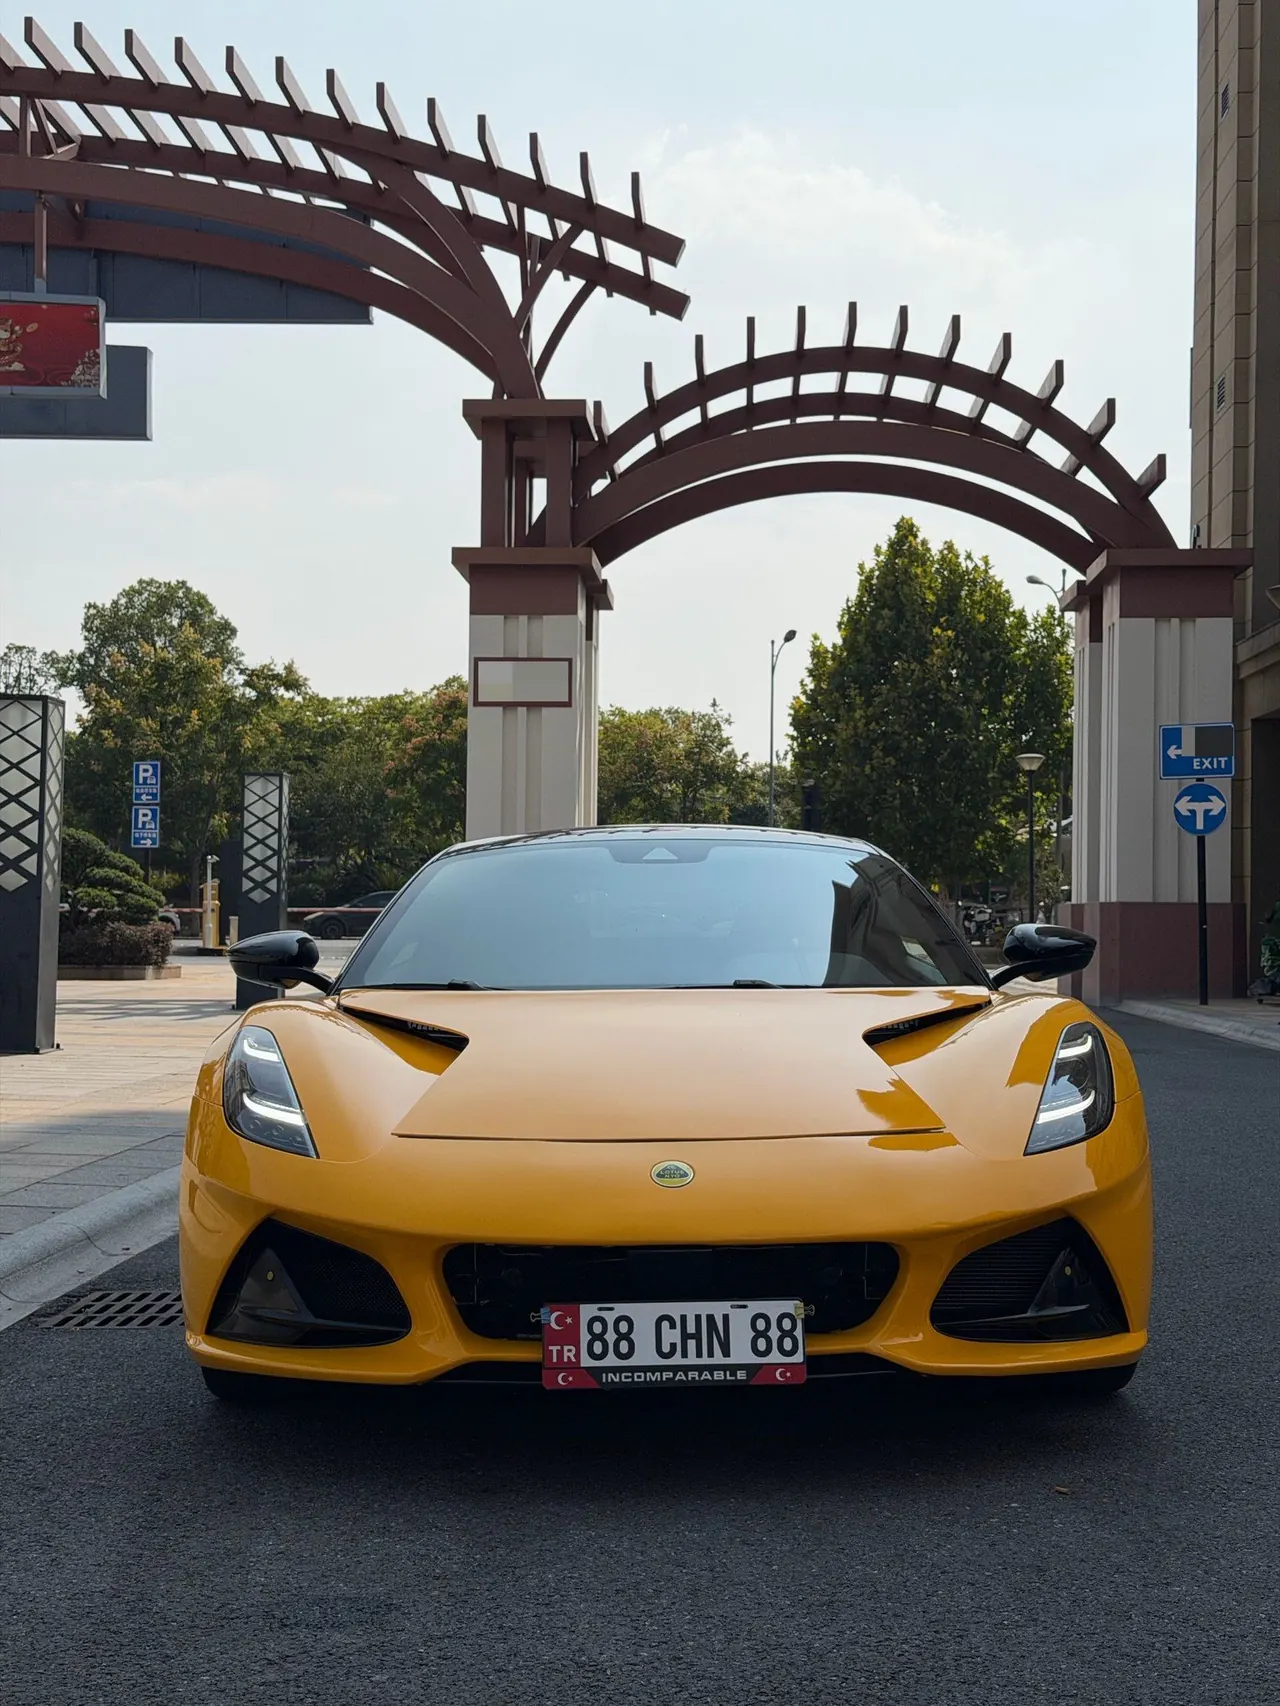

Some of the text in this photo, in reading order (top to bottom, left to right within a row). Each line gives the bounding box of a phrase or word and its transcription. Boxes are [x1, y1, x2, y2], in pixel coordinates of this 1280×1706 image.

[1193, 757, 1228, 769] EXIT
[139, 764, 153, 784] P
[138, 809, 152, 829] P
[587, 1312, 799, 1361] 88 CHN 88
[548, 1345, 576, 1362] TR
[602, 1370, 747, 1383] INCOMPARABLE
